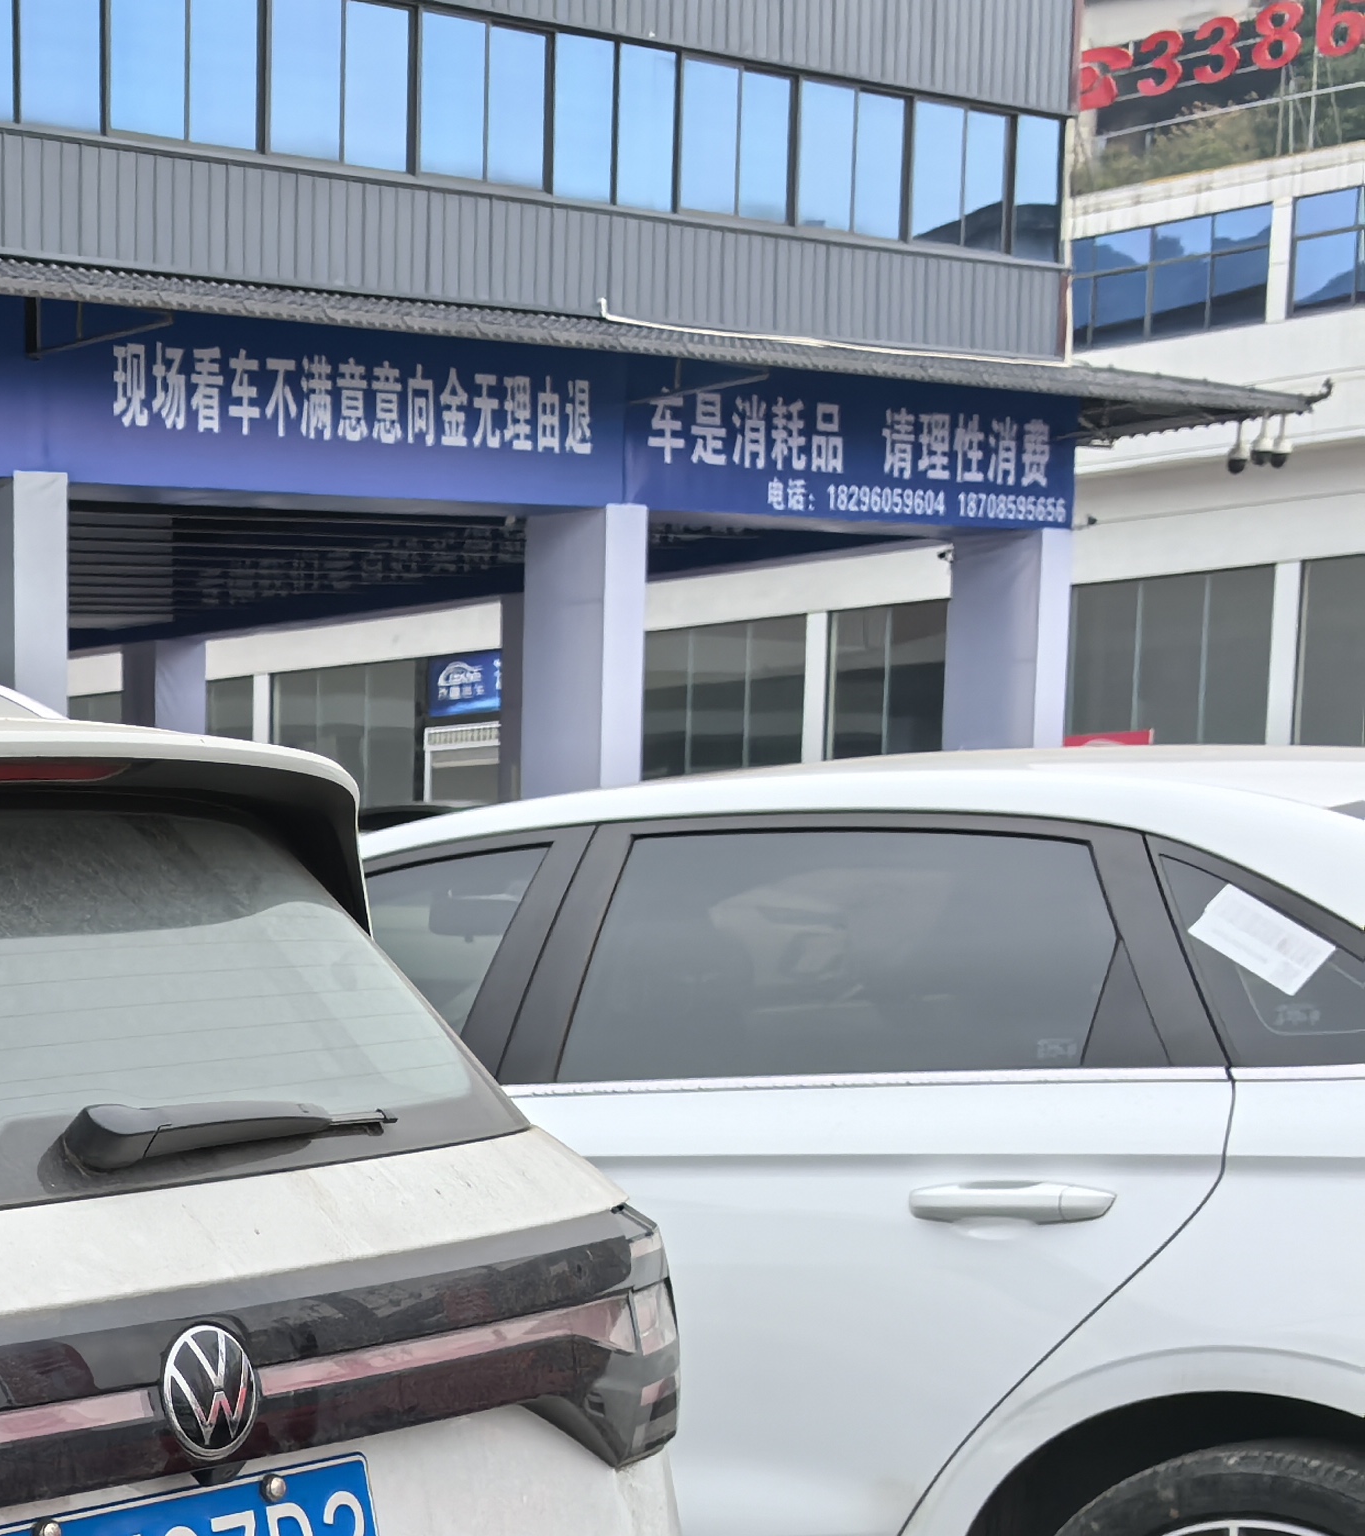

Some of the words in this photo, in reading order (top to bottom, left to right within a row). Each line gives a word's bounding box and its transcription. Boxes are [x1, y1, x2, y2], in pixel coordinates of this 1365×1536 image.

[112, 341, 593, 455] 现场看车不满意意向金无理由退
[647, 390, 844, 474] 车是消耗品
[881, 407, 1051, 488] 请理性消费
[826, 484, 946, 516] 18296059604
